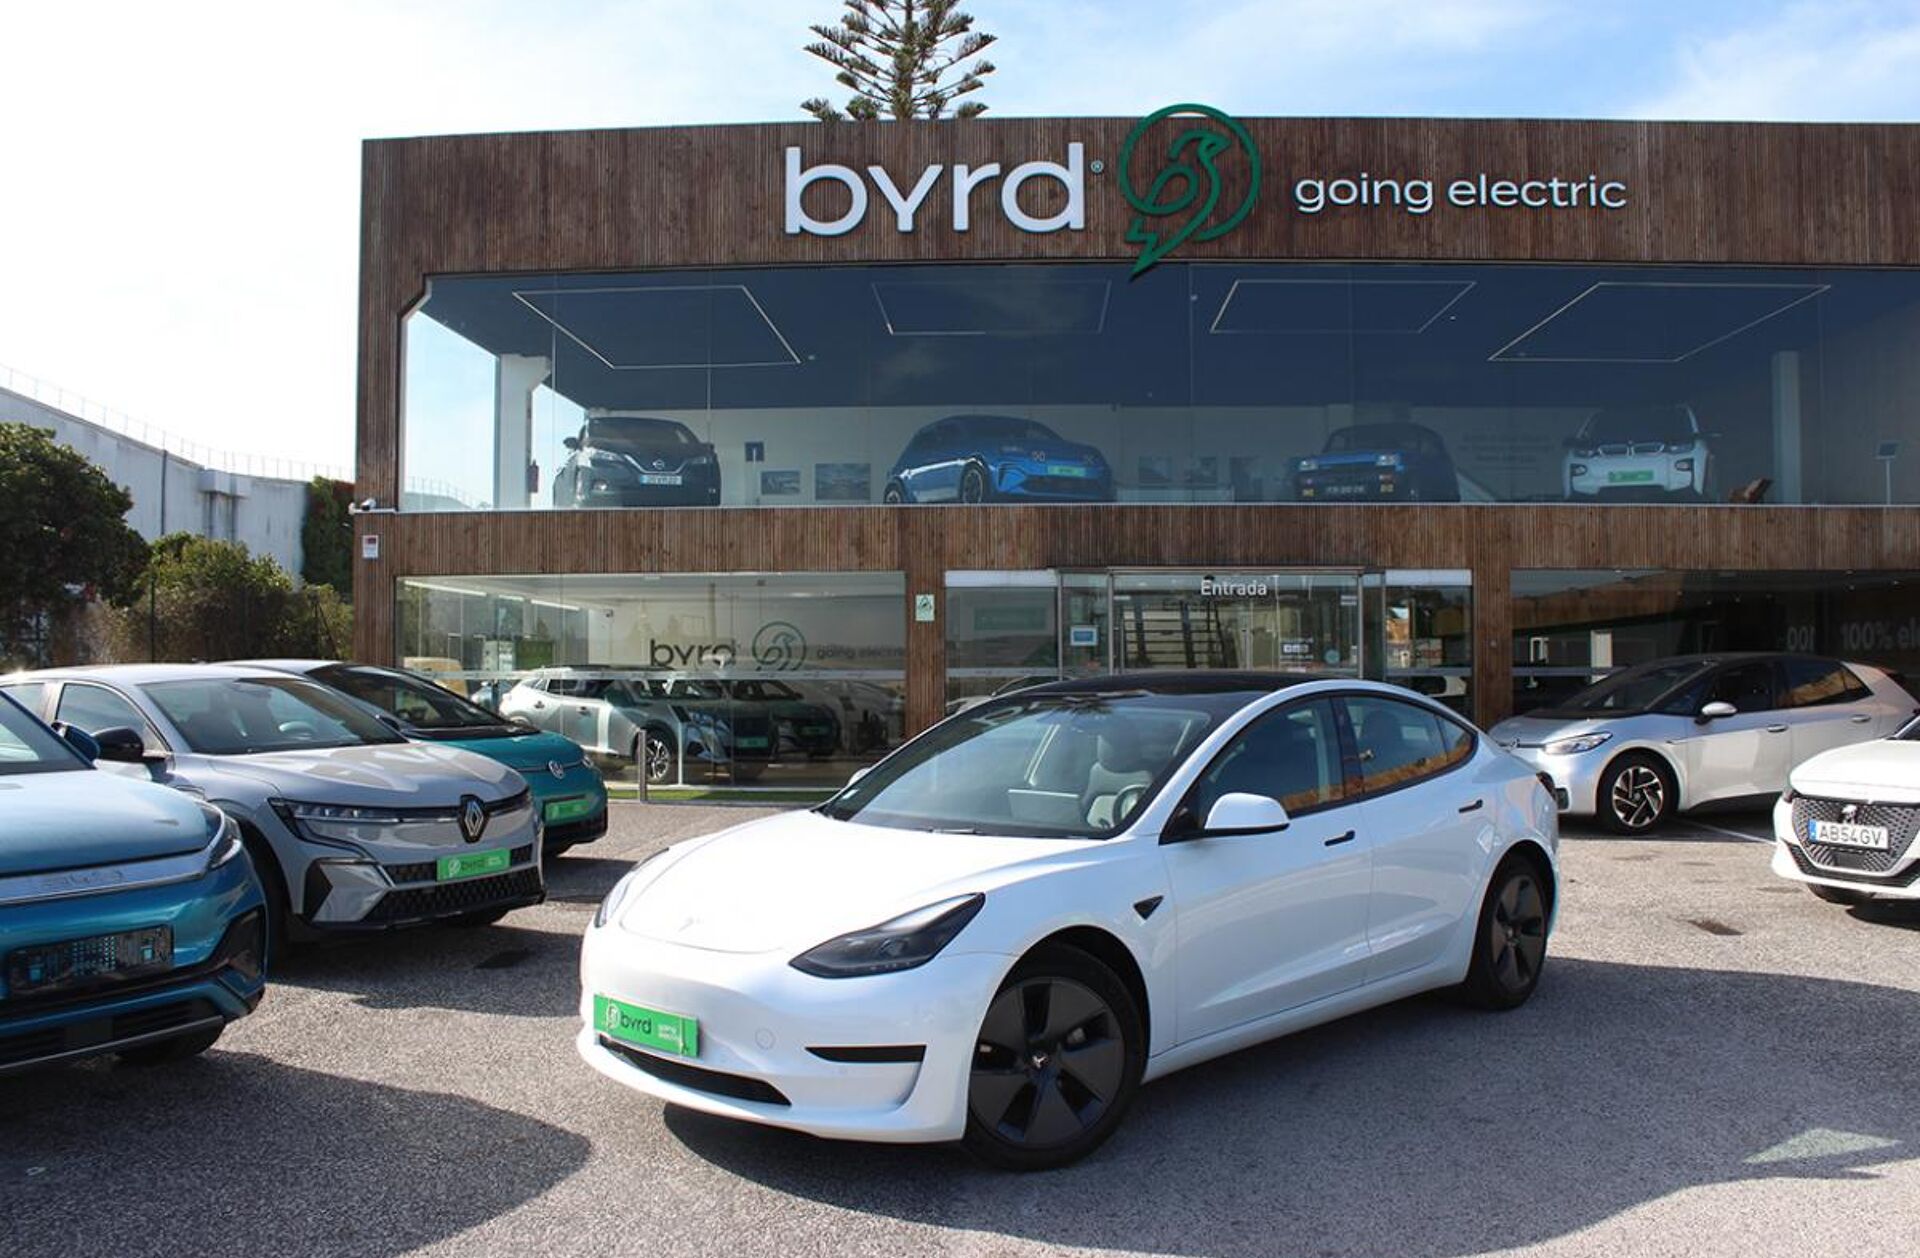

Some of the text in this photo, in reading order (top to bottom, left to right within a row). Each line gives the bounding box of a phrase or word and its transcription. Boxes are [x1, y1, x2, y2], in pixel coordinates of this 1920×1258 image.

[785, 142, 1627, 236] byrd going electric
[1201, 579, 1267, 596] Entrada
[1839, 621, 1894, 650] 100%
[650, 638, 737, 667] byrd
[1819, 825, 1881, 846] AB54GV
[620, 1009, 652, 1035] byrd
